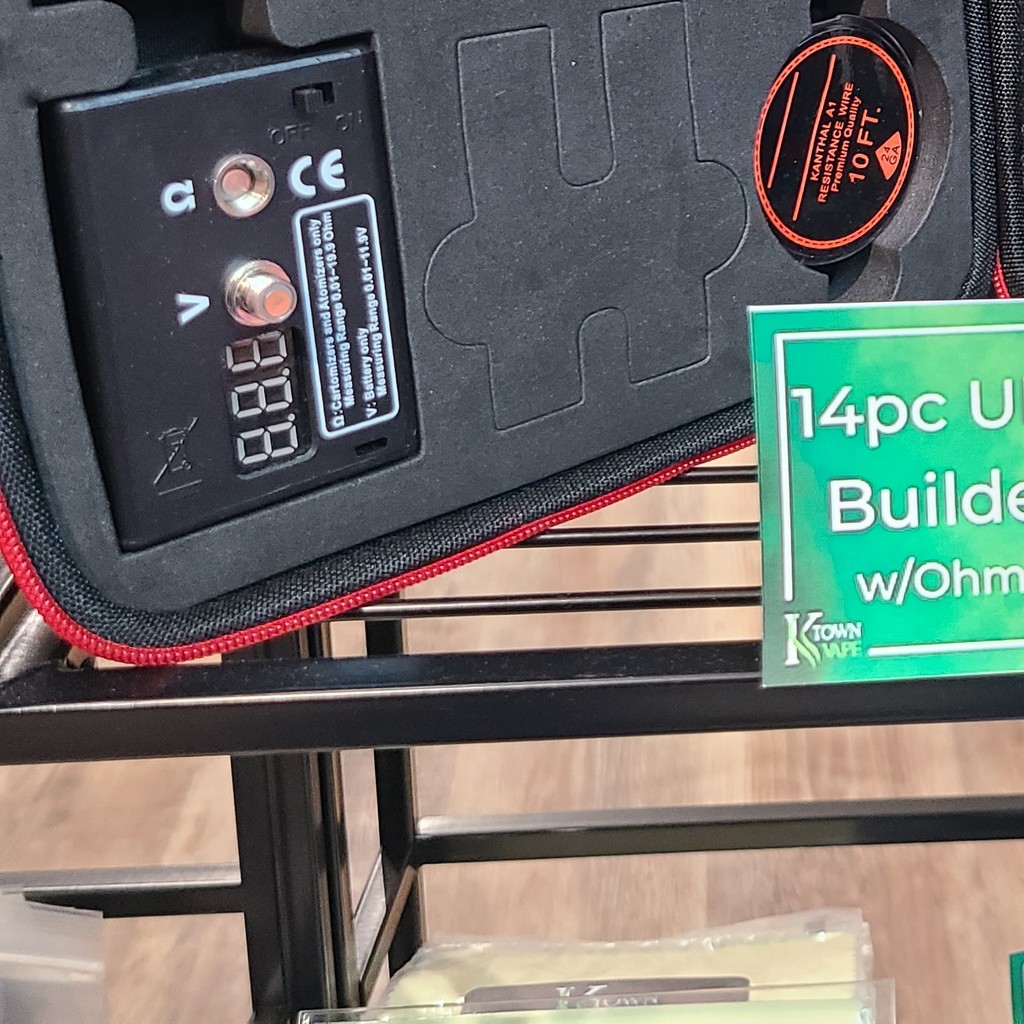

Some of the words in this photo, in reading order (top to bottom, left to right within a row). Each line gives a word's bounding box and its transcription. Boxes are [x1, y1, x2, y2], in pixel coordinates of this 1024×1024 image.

[809, 121, 831, 181] KANTHAL
[825, 101, 836, 118] A1
[818, 120, 845, 203] RESISTANCE
[838, 81, 855, 117] WIRE
[830, 139, 849, 193] Premium
[844, 95, 863, 137] Quality
[848, 152, 871, 183] 10
[790, 383, 947, 449] 14pc
